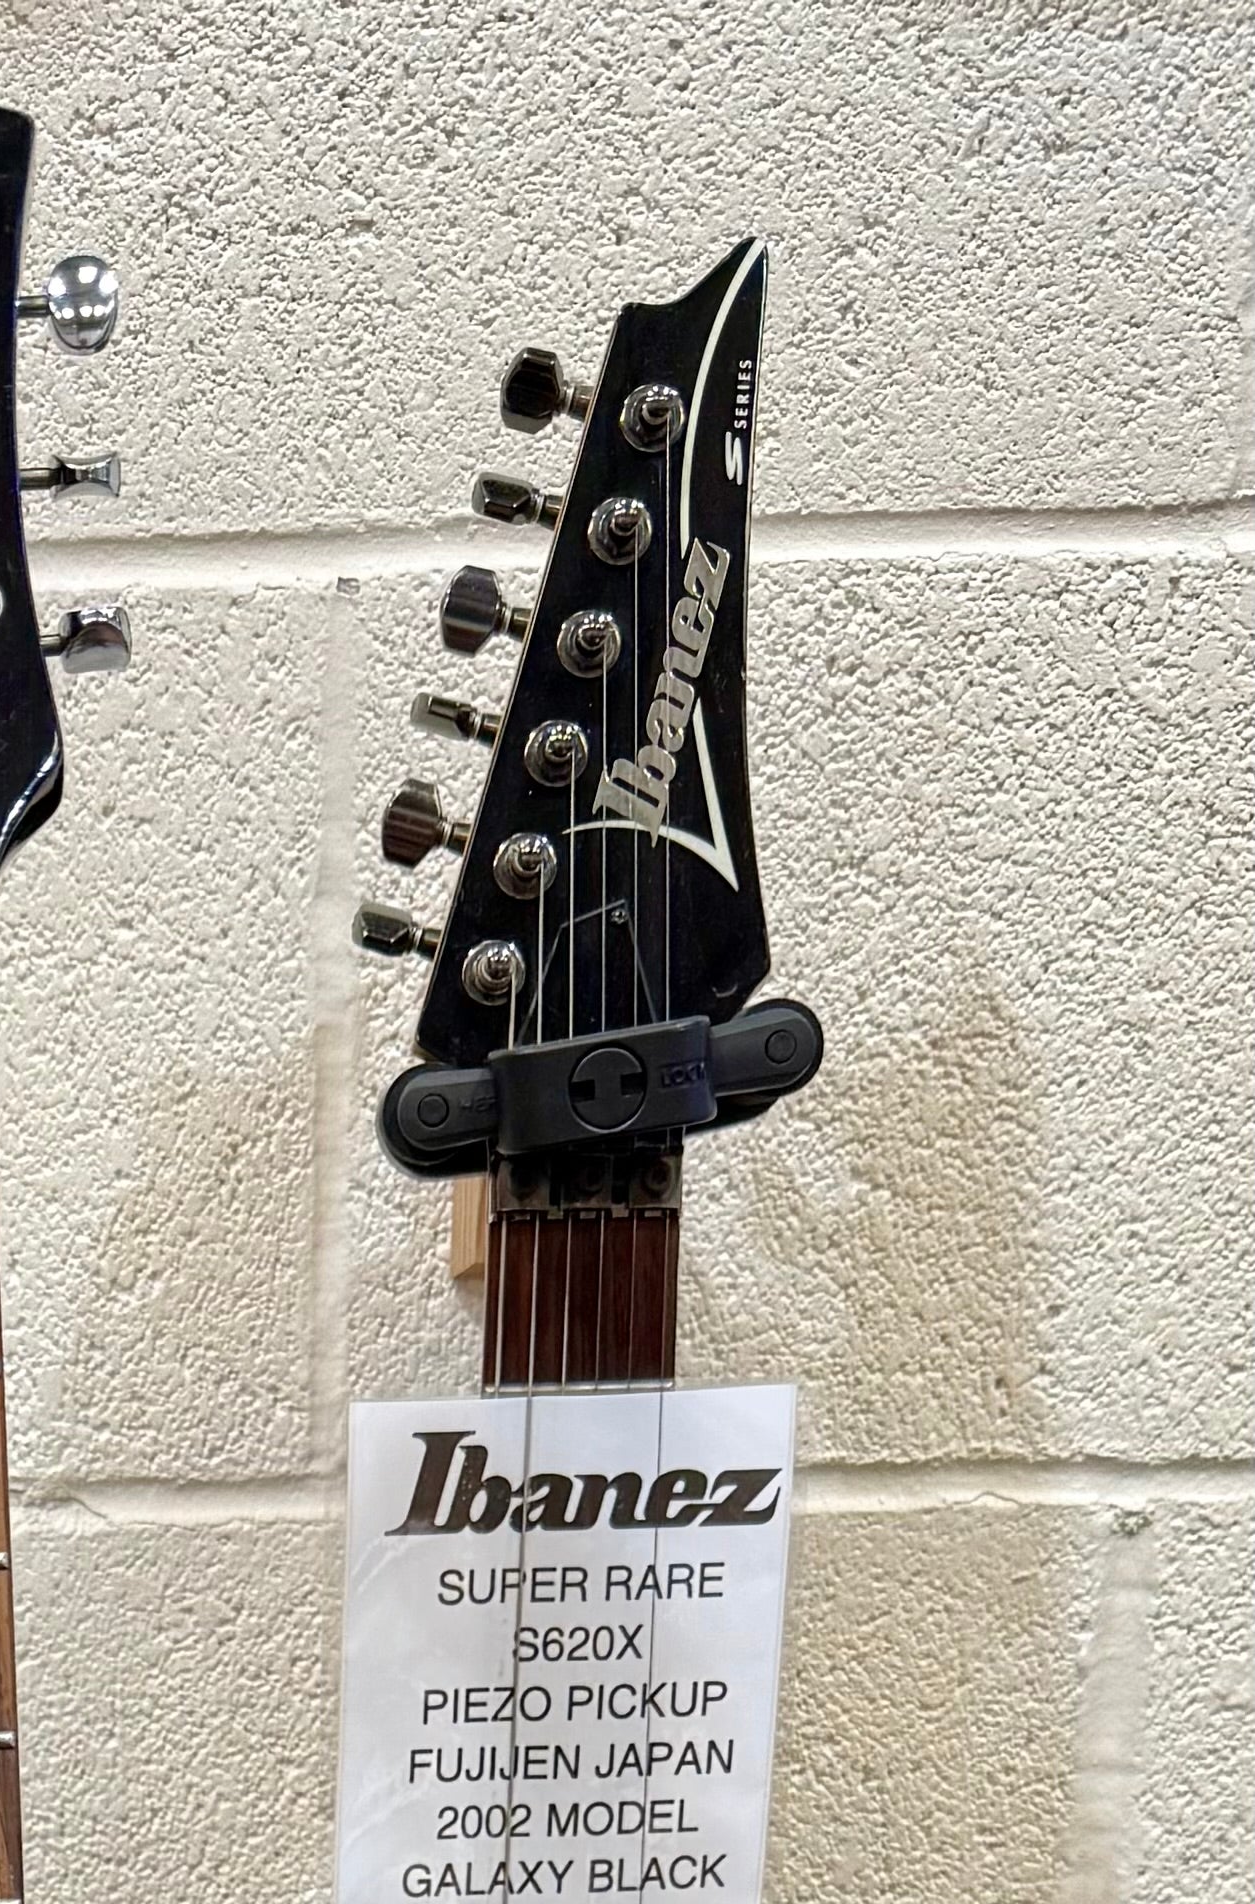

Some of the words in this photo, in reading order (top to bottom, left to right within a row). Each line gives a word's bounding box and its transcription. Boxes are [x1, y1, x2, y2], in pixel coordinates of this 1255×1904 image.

[725, 431, 743, 486] S
[734, 359, 753, 430] SERIES
[592, 537, 730, 849] Ibanez
[384, 1430, 784, 1537] Ibanez
[437, 1567, 588, 1605] SUPER
[605, 1561, 725, 1601] RARE
[514, 1624, 644, 1663] S620X
[422, 1684, 551, 1726] PIEZO
[567, 1680, 728, 1723] PICKUP
[408, 1744, 581, 1785] FUJIJEN
[594, 1738, 735, 1779] JAPAN
[437, 1804, 532, 1841] 2002
[546, 1799, 699, 1838] MODEL
[401, 1859, 574, 1899] GALAXY
[588, 1853, 727, 1895] BLACK
